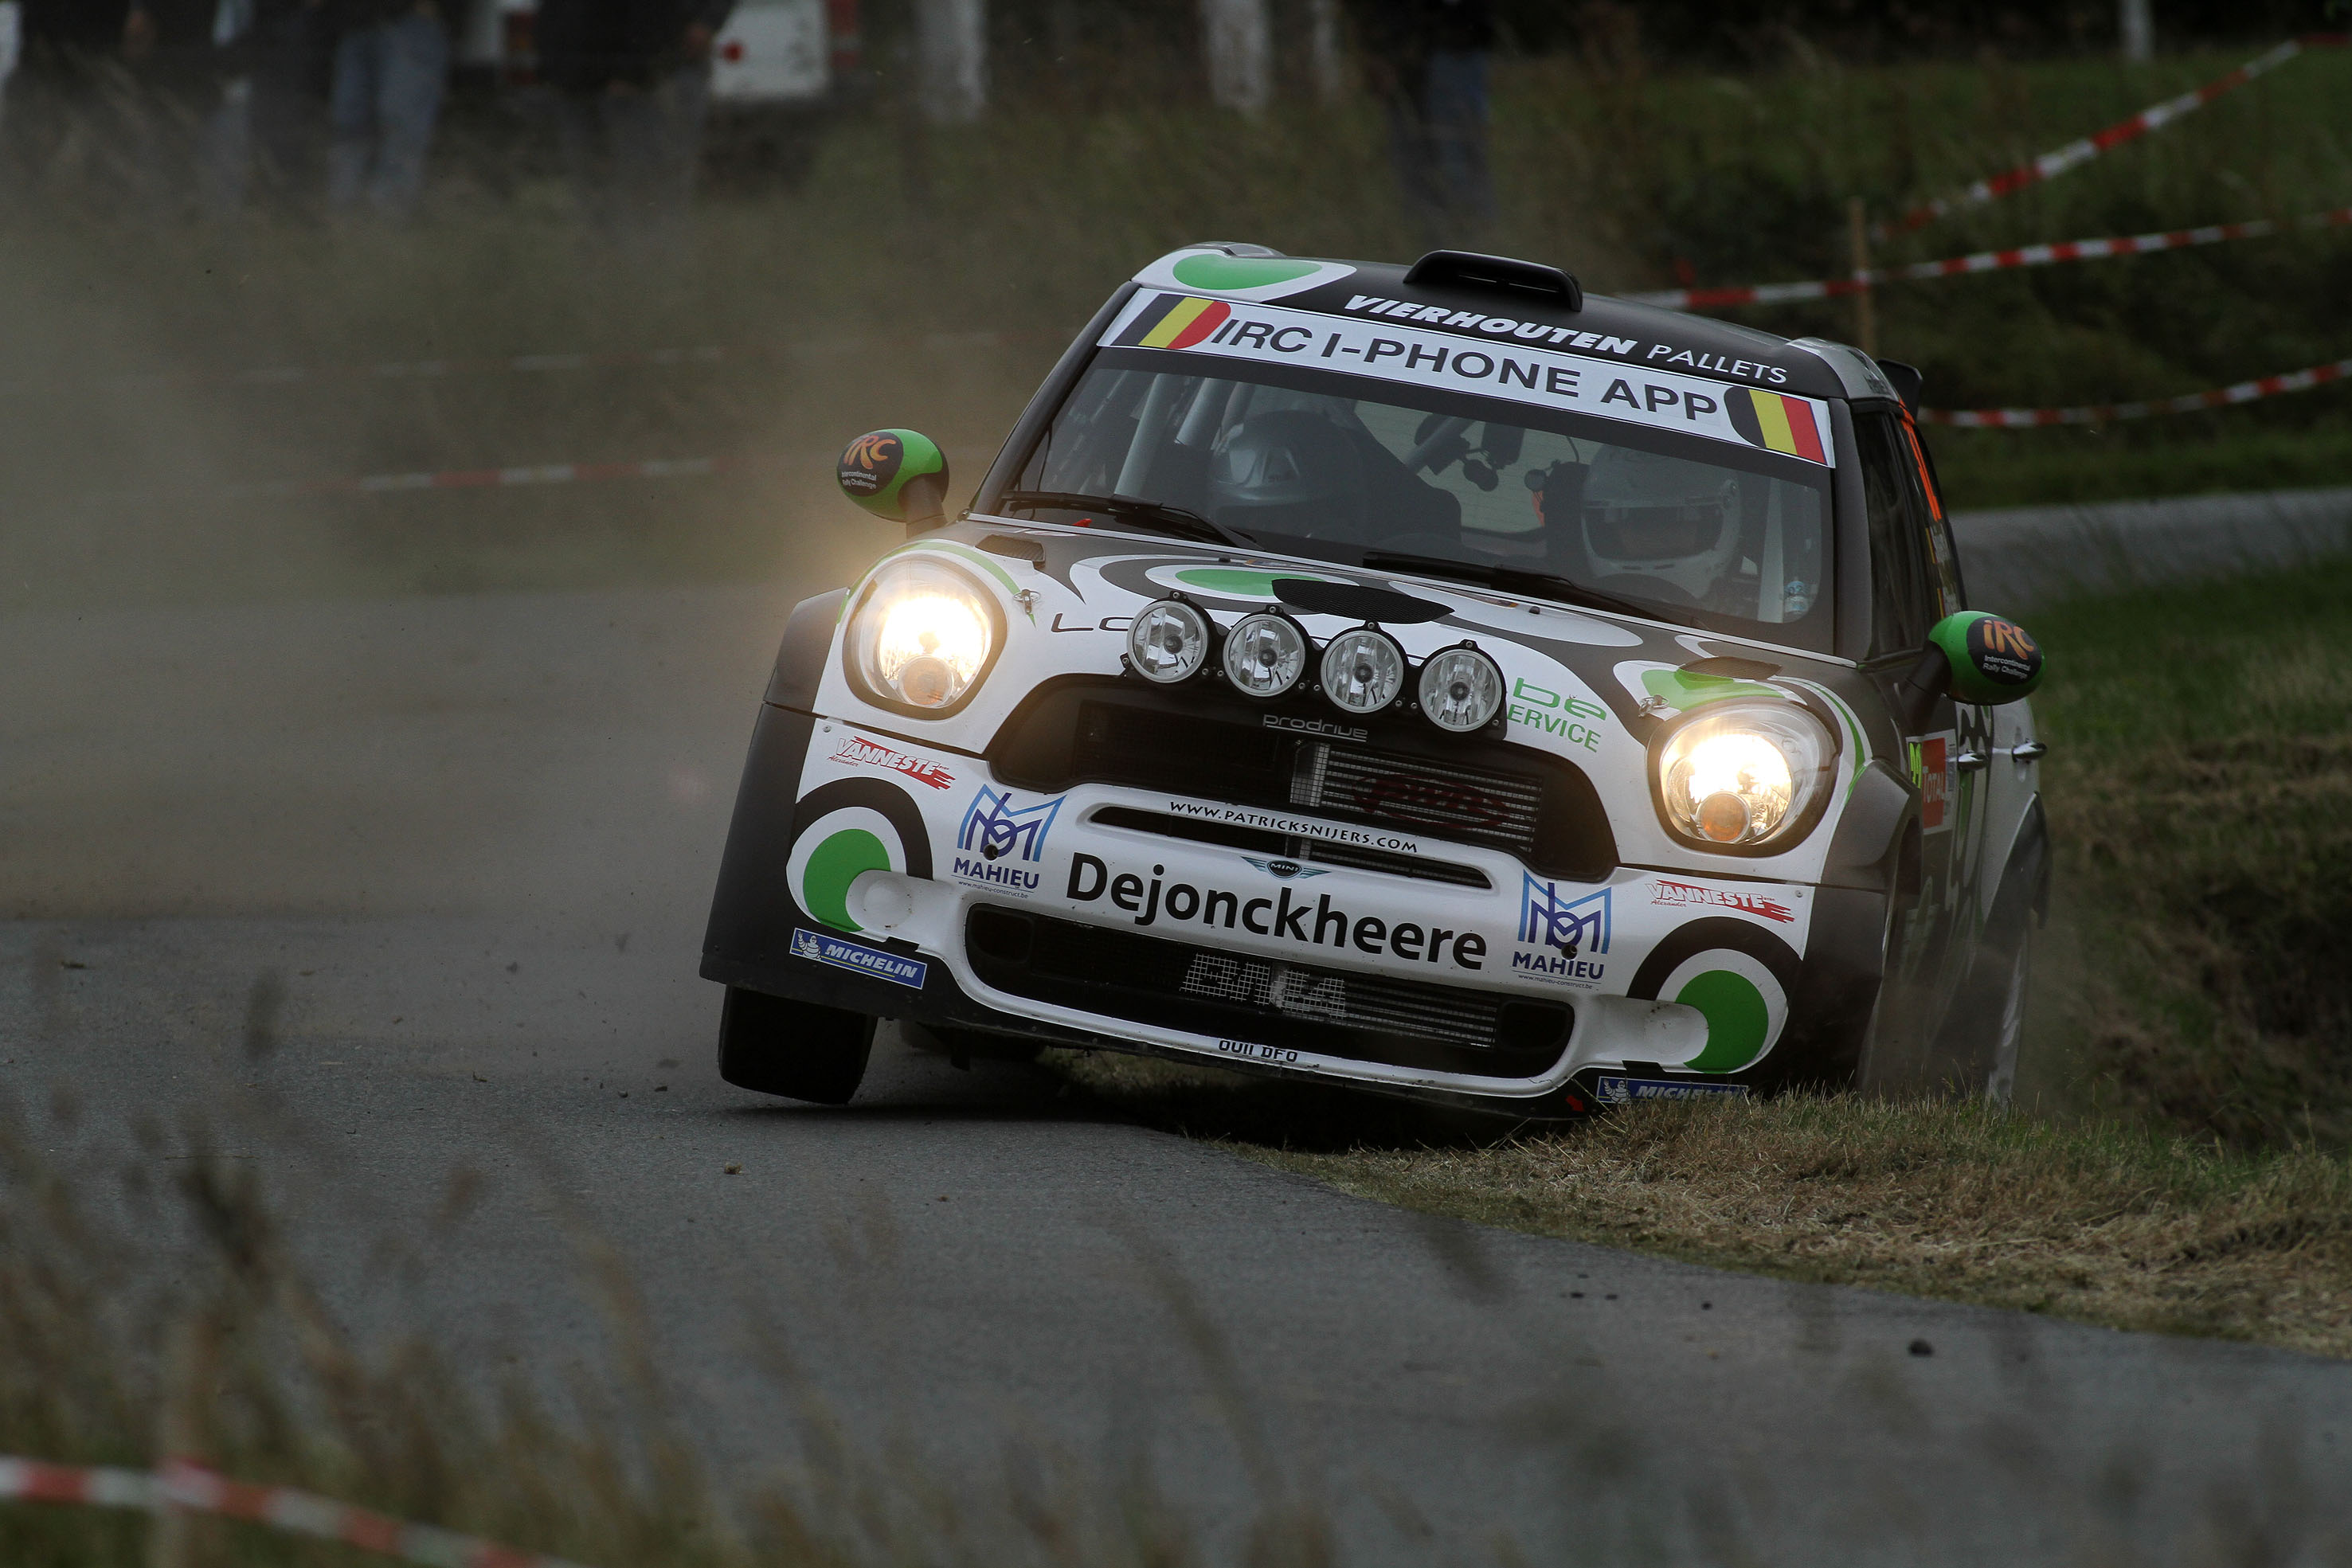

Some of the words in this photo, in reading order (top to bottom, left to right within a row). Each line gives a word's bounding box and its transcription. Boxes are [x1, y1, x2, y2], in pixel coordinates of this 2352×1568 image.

[1344, 295, 1638, 355] VIERHOUTEN
[1646, 344, 1788, 384] PALLETS
[1211, 319, 1313, 353] IRC
[1321, 333, 1581, 398] I-PHONE
[1600, 378, 1718, 420] APP
[1507, 704, 1602, 753] ERVICE
[836, 738, 941, 776] VANNESTE
[1170, 802, 1418, 853] WWW.PATRICKSNIJERS.COM
[953, 857, 1039, 890] MAHIEU
[1270, 862, 1299, 872] MINI
[1066, 852, 1487, 971] Dejonckheere
[1645, 883, 1766, 909] VANNESTE
[824, 944, 918, 979] MICHELIN
[1512, 951, 1605, 980] MAHIEU
[1261, 1046, 1299, 1063] DFO
